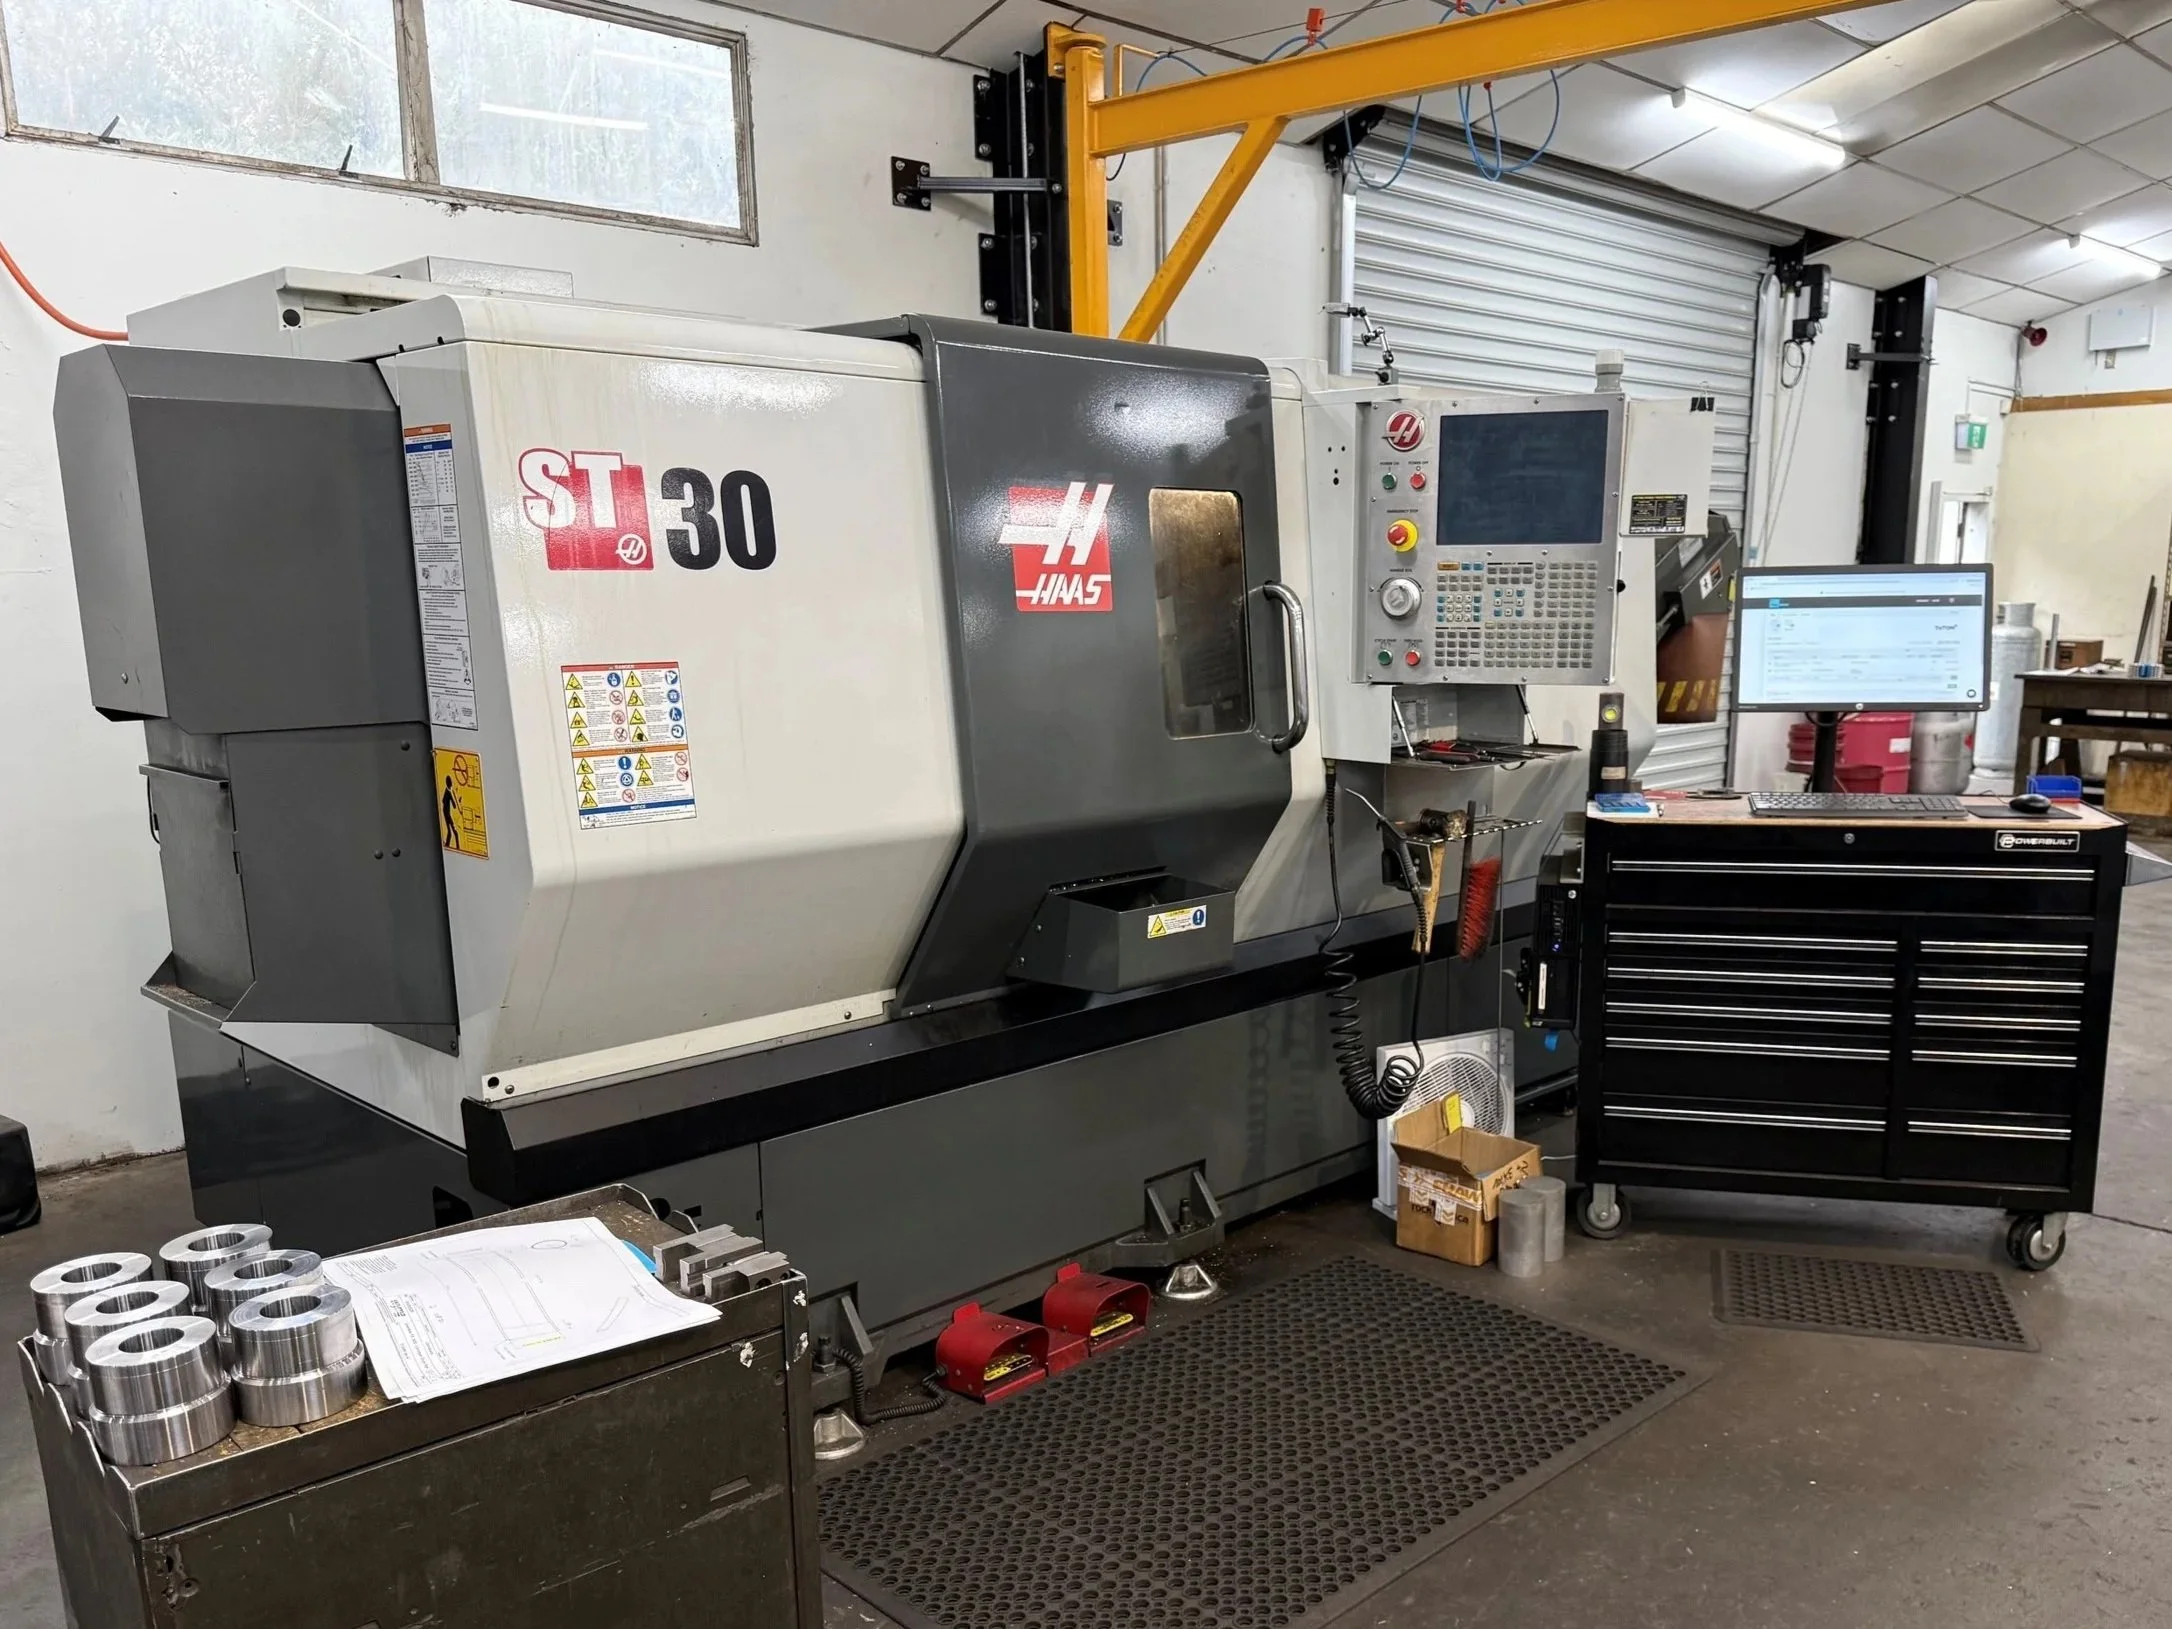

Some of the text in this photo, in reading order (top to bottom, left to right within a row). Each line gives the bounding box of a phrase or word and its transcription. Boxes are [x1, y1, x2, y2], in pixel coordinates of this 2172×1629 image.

[518, 447, 623, 530] ST
[661, 467, 777, 571] 30
[1015, 573, 1112, 605] HAAS
[1999, 834, 2076, 849] POWERBUILT
